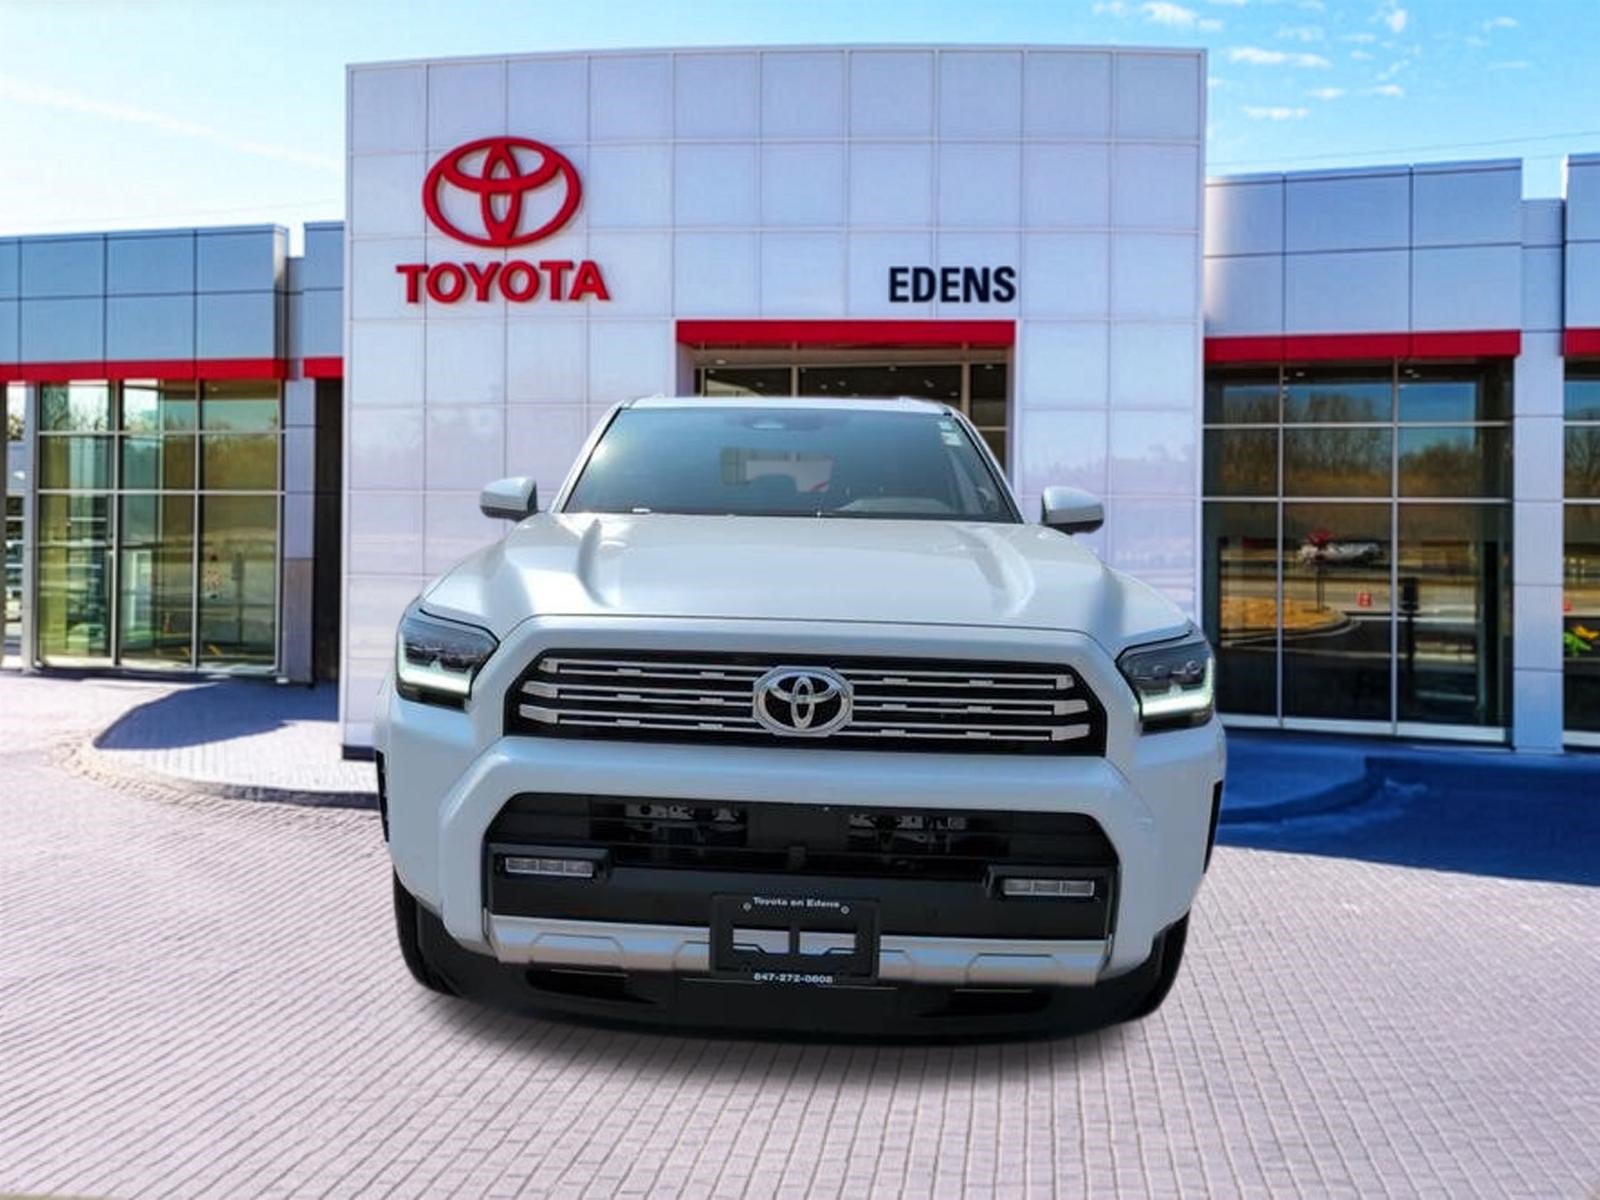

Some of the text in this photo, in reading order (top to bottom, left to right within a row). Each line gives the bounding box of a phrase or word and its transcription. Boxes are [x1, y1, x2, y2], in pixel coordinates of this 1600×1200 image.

[396, 260, 611, 303] TOYOTA
[889, 266, 1016, 303] EDENS
[753, 896, 788, 907] Toyota
[806, 898, 840, 908] Edens
